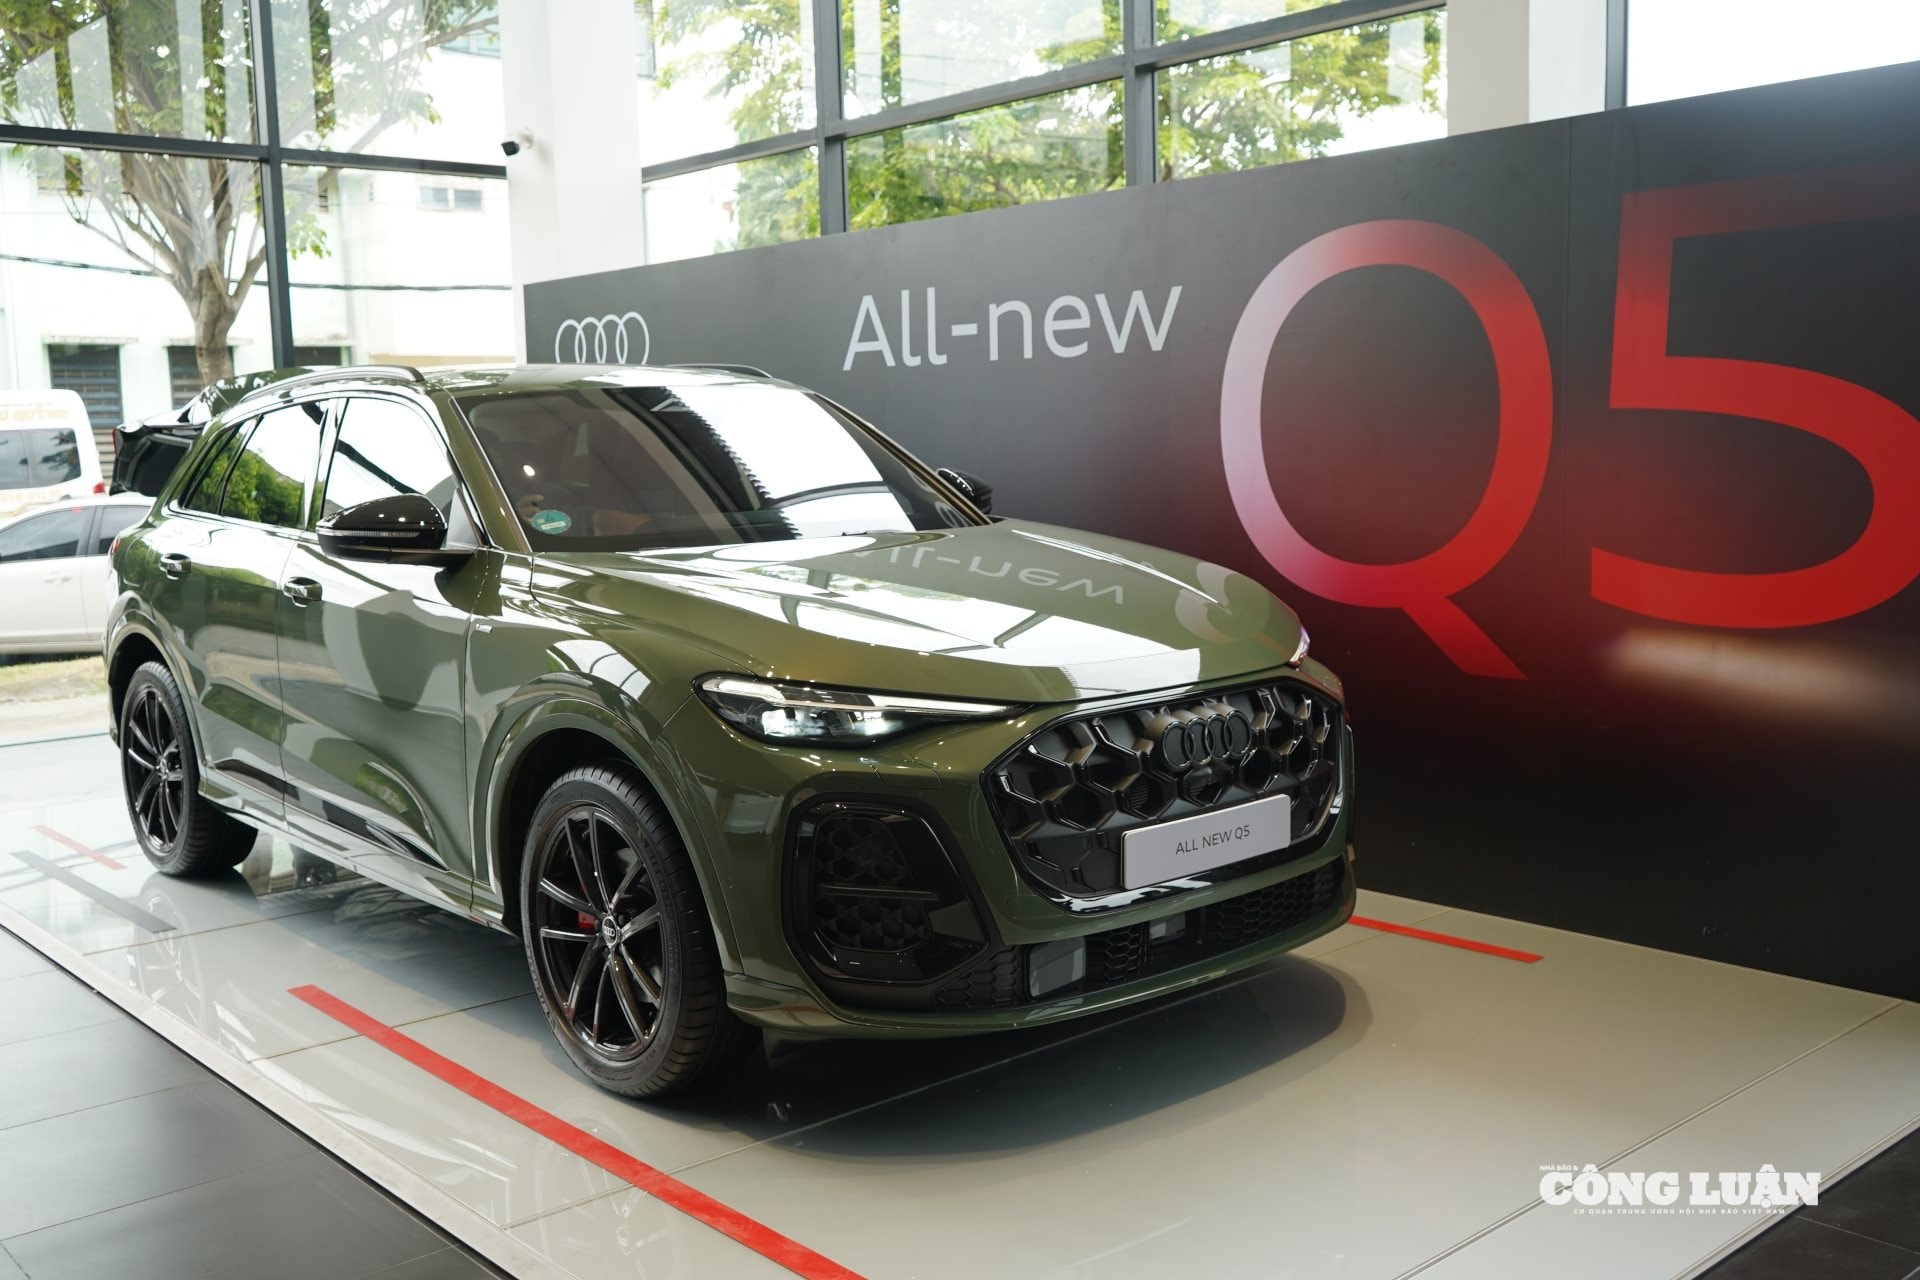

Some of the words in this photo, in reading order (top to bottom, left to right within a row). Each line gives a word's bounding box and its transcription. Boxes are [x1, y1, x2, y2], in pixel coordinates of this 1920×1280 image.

[843, 286, 1183, 371] All-new
[1219, 160, 1920, 680] Q5
[1175, 839, 1199, 855] ALL
[1202, 830, 1232, 847] NEW
[1235, 825, 1250, 840] Q5
